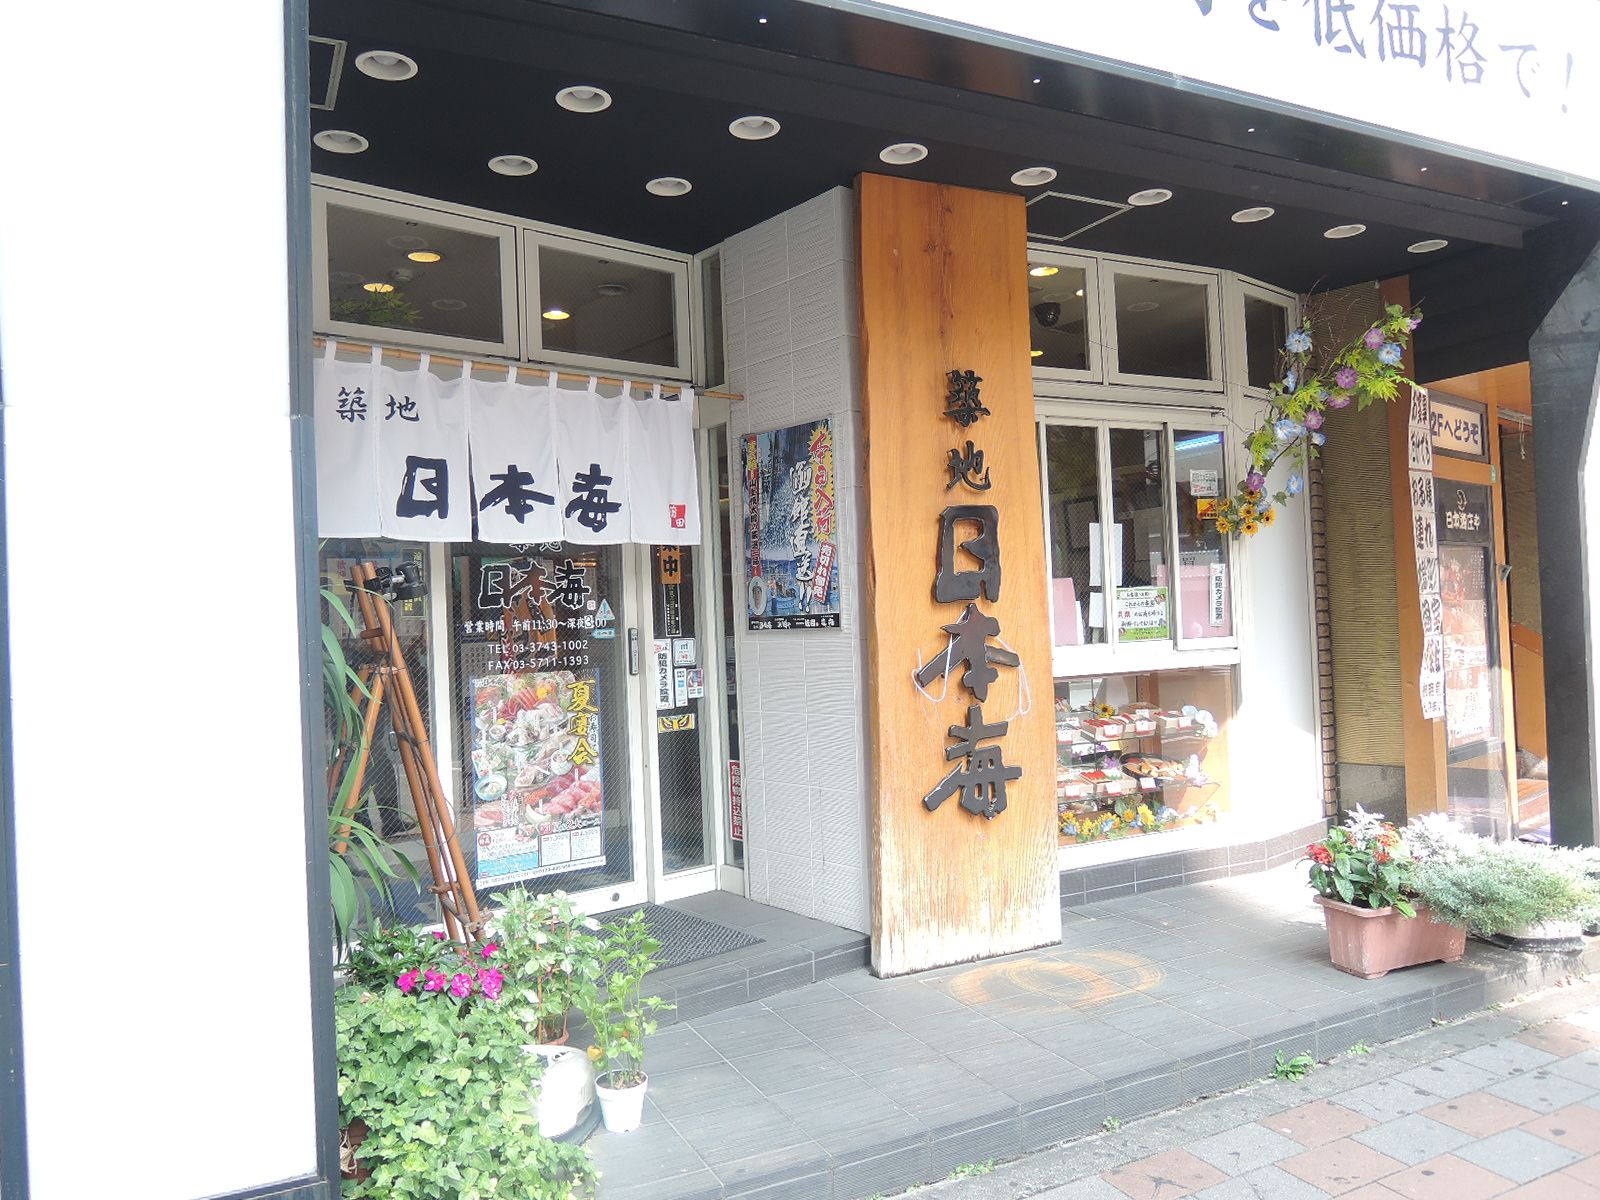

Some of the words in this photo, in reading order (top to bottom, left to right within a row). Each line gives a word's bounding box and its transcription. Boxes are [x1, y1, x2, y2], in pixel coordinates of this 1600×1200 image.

[334, 385, 421, 423] 築地
[1430, 411, 1479, 445] 2Fへどうぞ
[395, 454, 623, 533] 日本海
[477, 558, 592, 610] 日本海
[463, 619, 505, 634] 営業時間
[487, 644, 510, 655] TEL
[512, 639, 589, 654] 03-3743-1002
[487, 660, 511, 671] FAX
[512, 655, 589, 670] 03-5711-1393
[657, 652, 670, 704] 防犯カメラ設置
